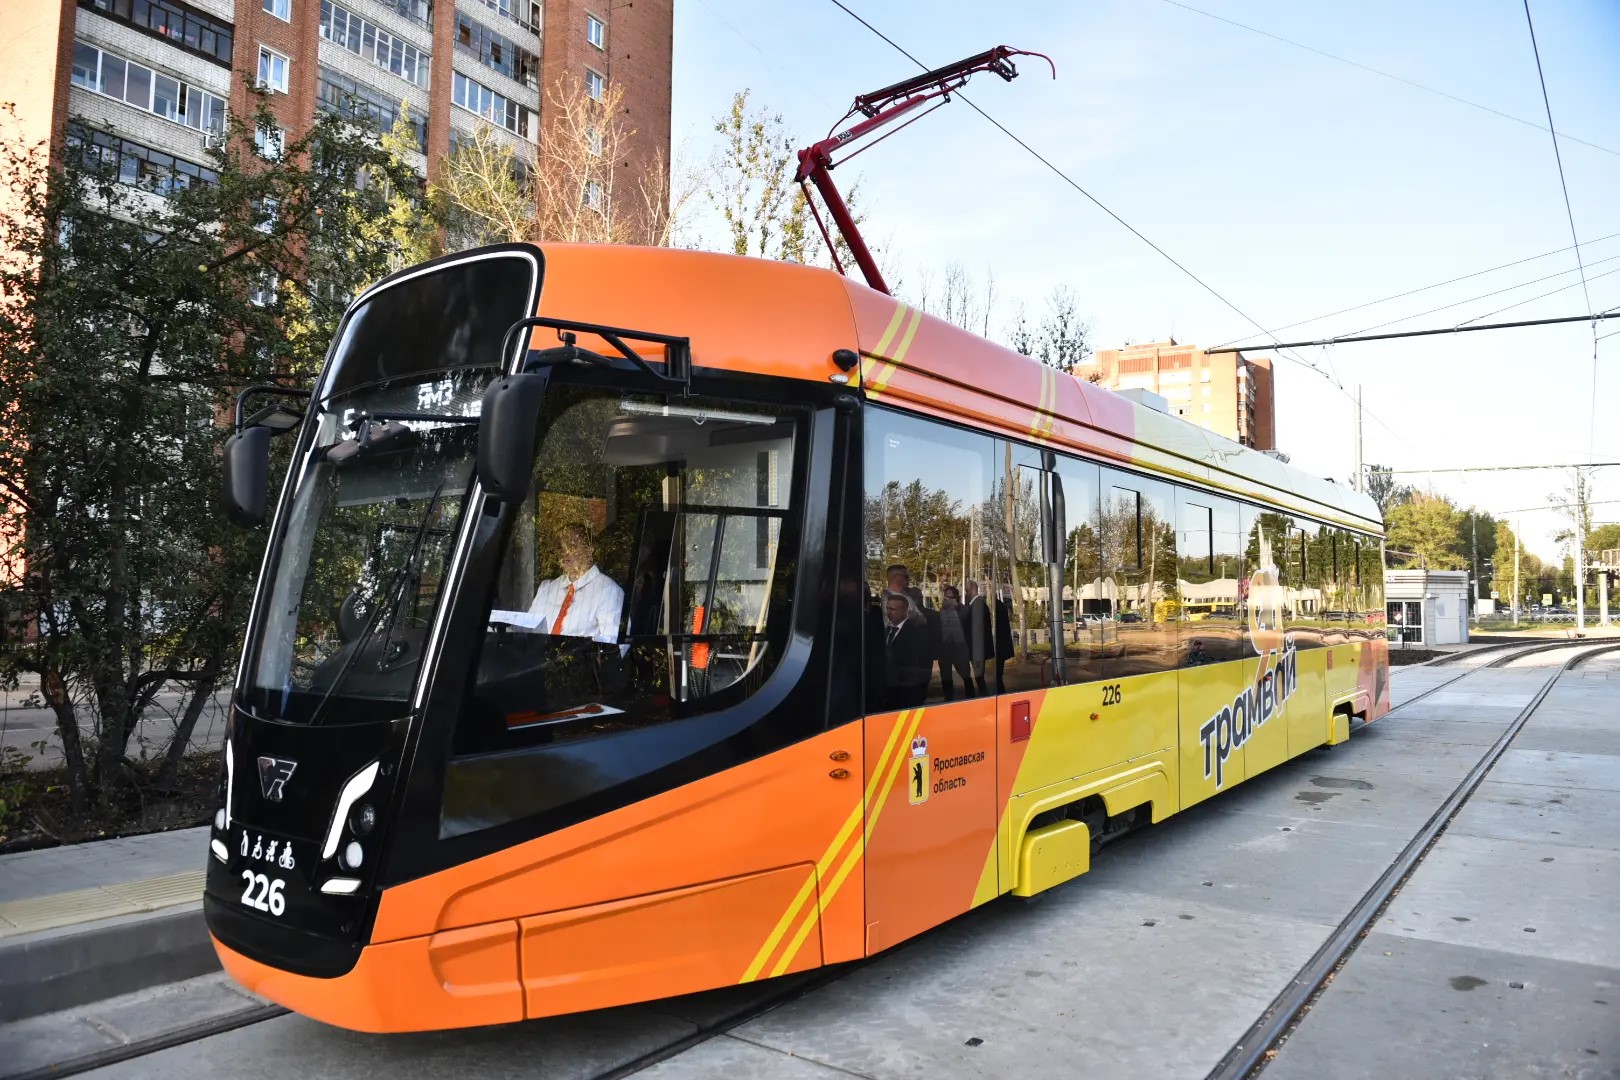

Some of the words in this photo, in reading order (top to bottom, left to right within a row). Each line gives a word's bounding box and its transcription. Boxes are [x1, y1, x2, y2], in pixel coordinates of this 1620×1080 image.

[1102, 684, 1121, 706] 226
[933, 750, 985, 772] Ярославская
[933, 776, 966, 794] область
[241, 870, 286, 917] 226
